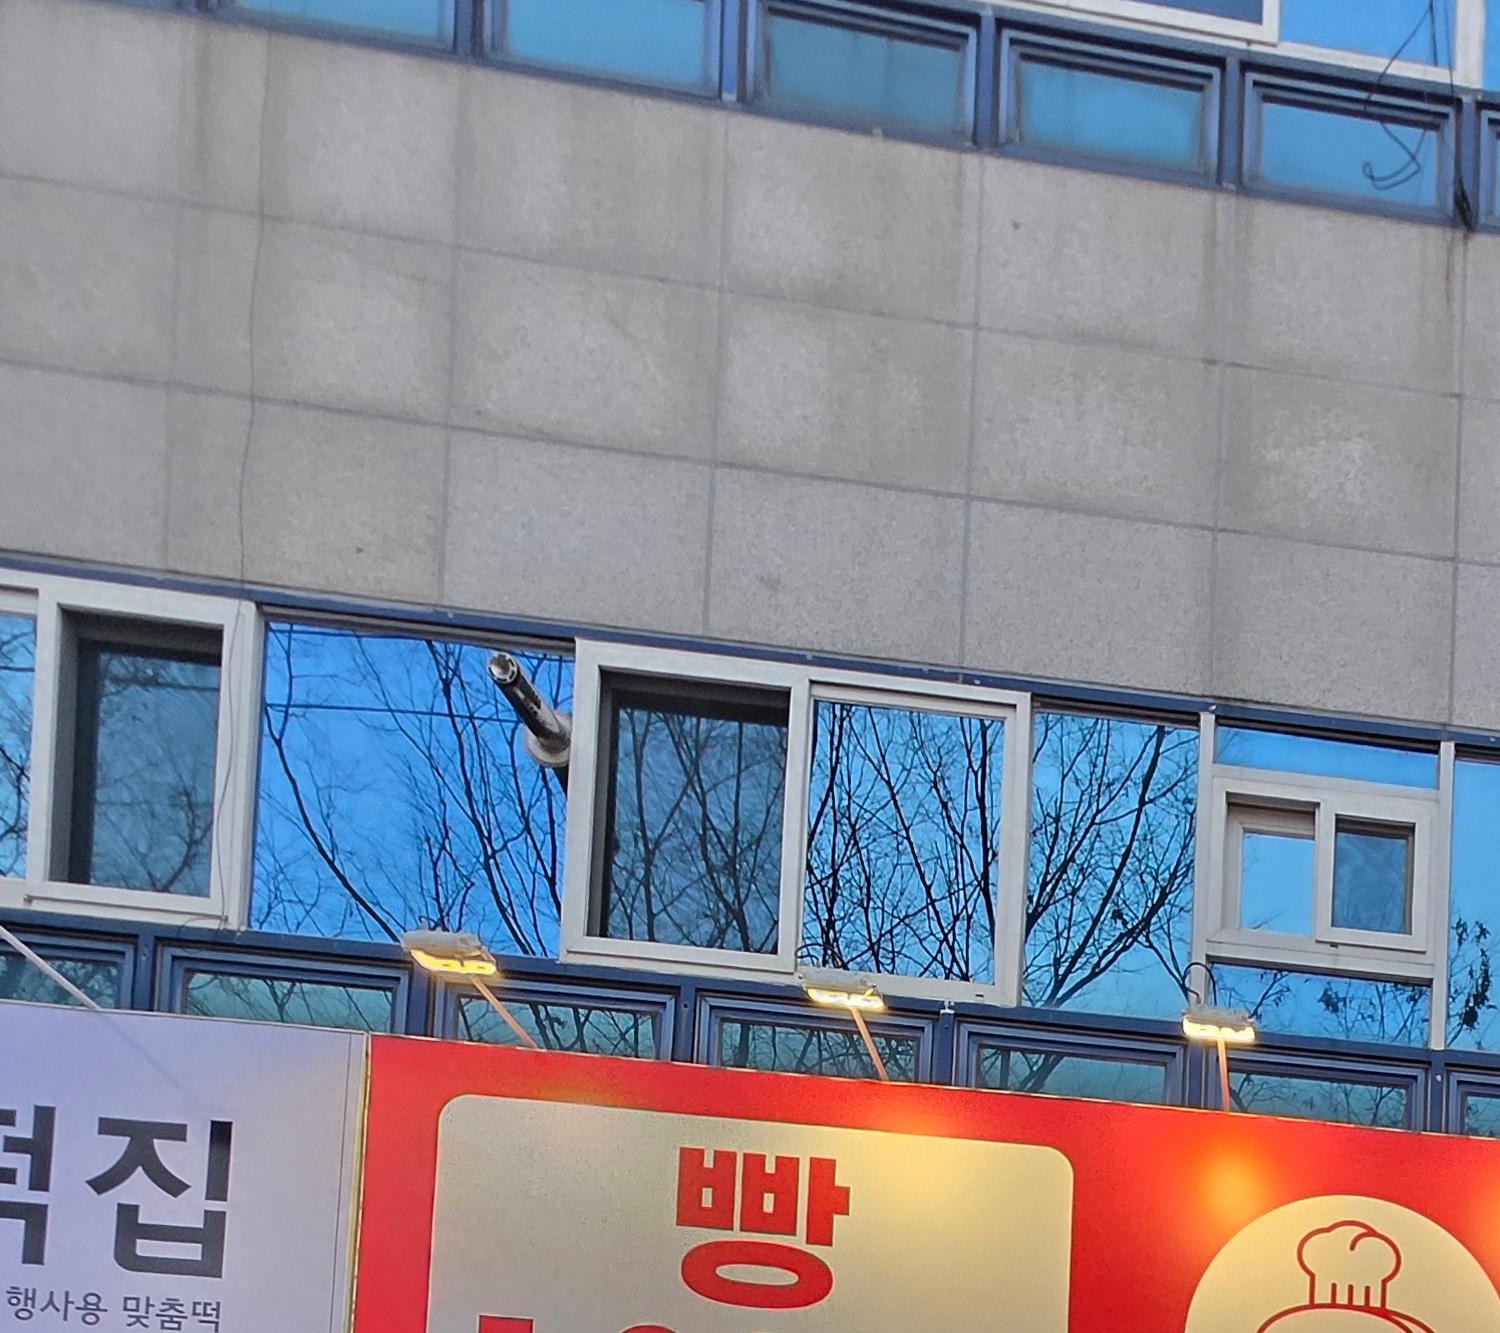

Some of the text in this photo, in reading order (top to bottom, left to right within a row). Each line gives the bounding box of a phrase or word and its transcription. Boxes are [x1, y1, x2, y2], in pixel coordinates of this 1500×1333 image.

[676, 1146, 850, 1310] 빵
[6, 1285, 222, 1332] 행사용 맞춤떡
